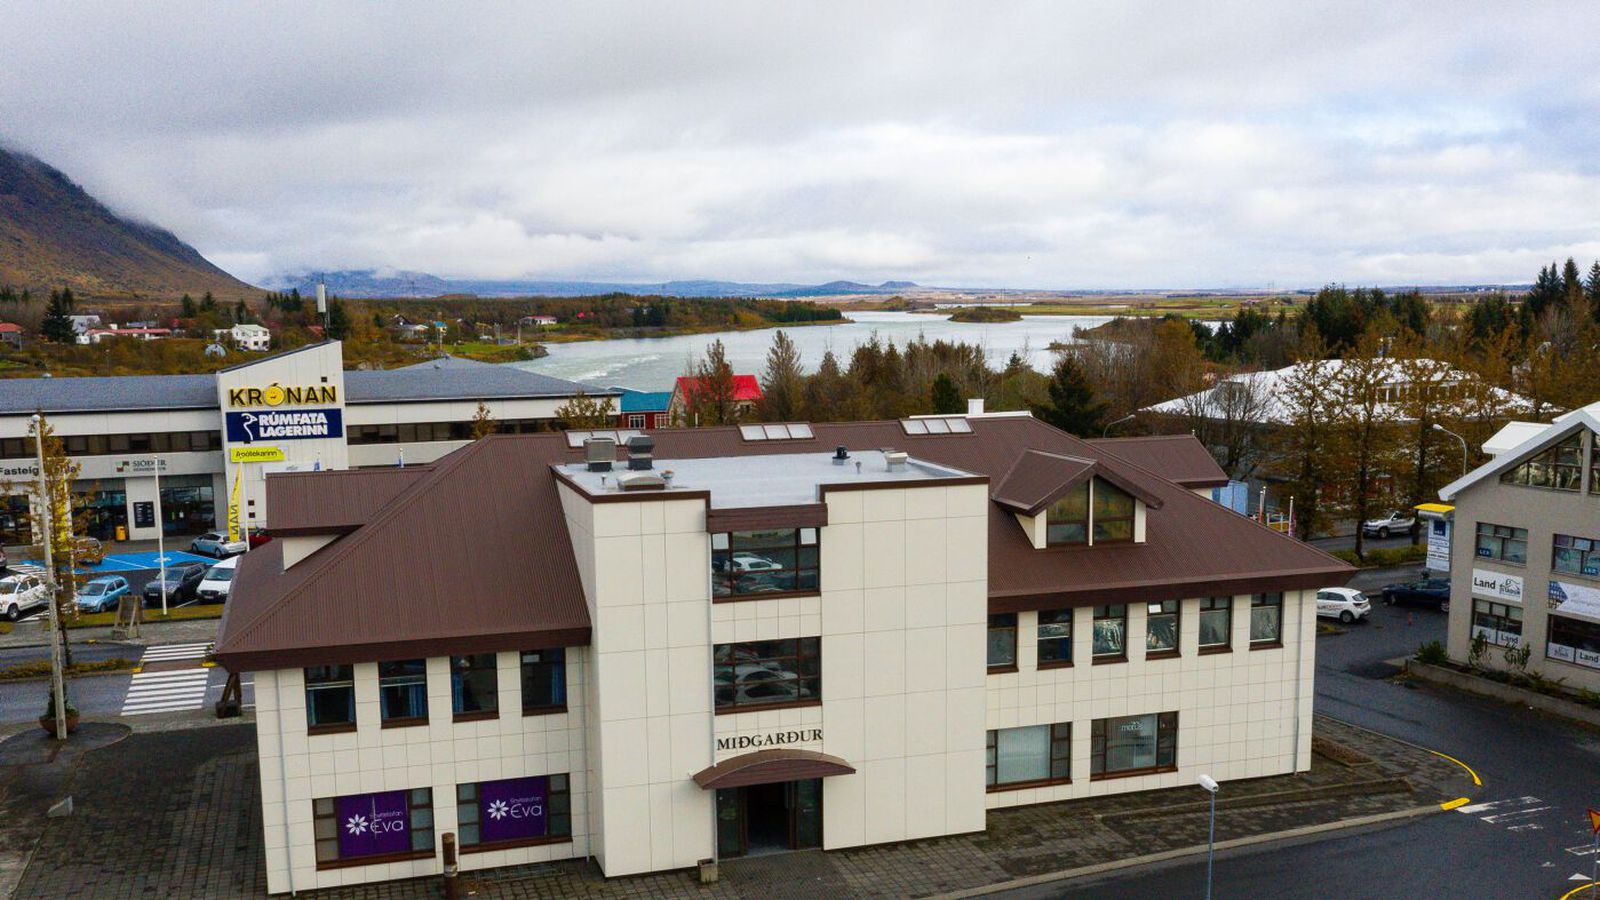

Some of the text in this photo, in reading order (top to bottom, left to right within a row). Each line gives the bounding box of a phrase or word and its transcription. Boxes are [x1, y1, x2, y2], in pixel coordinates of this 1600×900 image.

[229, 383, 337, 407] KRÓNAN
[259, 411, 328, 426] RÚMFATA
[259, 424, 328, 437] LAGERINN
[1473, 577, 1496, 590] Land
[1500, 634, 1519, 645] Land
[1579, 651, 1599, 663] Land
[717, 729, 823, 751] MIÐGARÐUR
[510, 803, 541, 819] Eva
[370, 818, 403, 834] Eva
